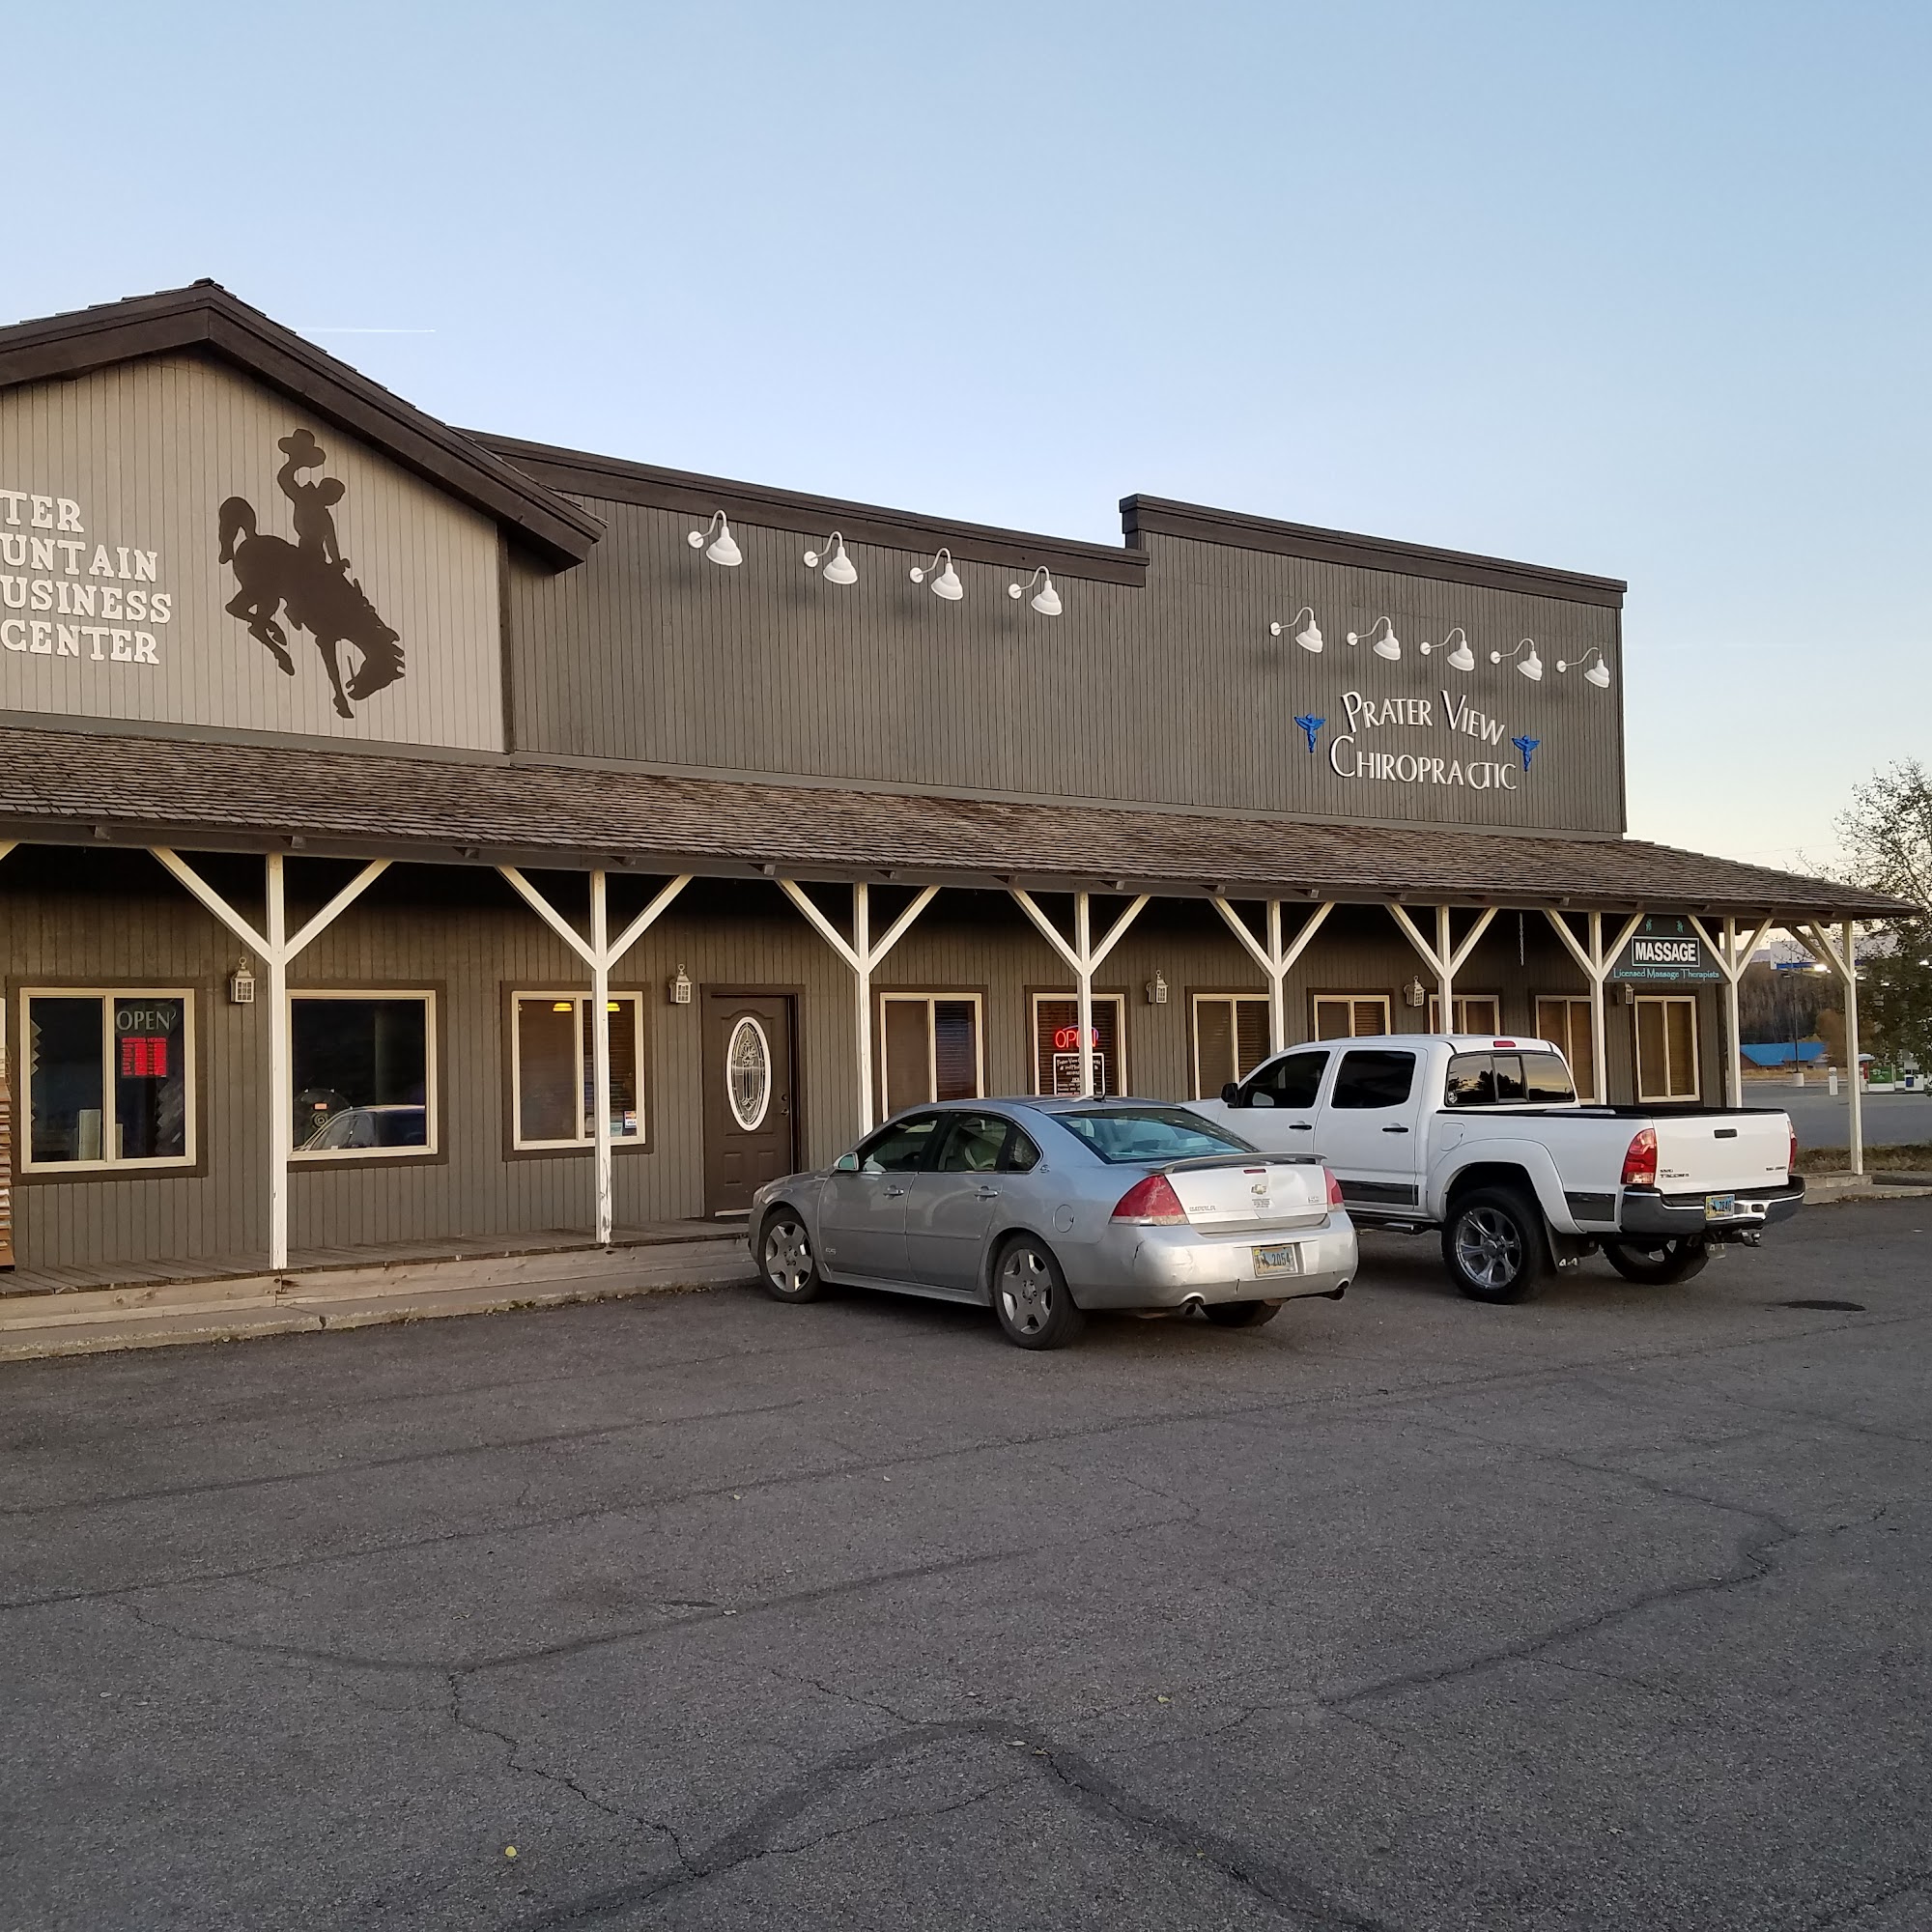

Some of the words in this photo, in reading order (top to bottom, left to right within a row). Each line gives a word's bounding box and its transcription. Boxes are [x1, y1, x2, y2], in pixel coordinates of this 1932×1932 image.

[0, 489, 84, 533] TER
[0, 532, 157, 582] UNTAIN
[0, 575, 172, 624] USINESS
[0, 619, 159, 665] CENTER
[1341, 691, 1433, 733] PRATER
[1440, 689, 1505, 746] VIEW
[1330, 735, 1517, 790] CHIROPRACTIC
[1613, 968, 1646, 979] Licensed
[1647, 968, 1680, 980] Massage
[1681, 968, 1719, 981] Therapists
[1634, 942, 1696, 962] MASSAGE
[116, 1010, 171, 1031] OPEN
